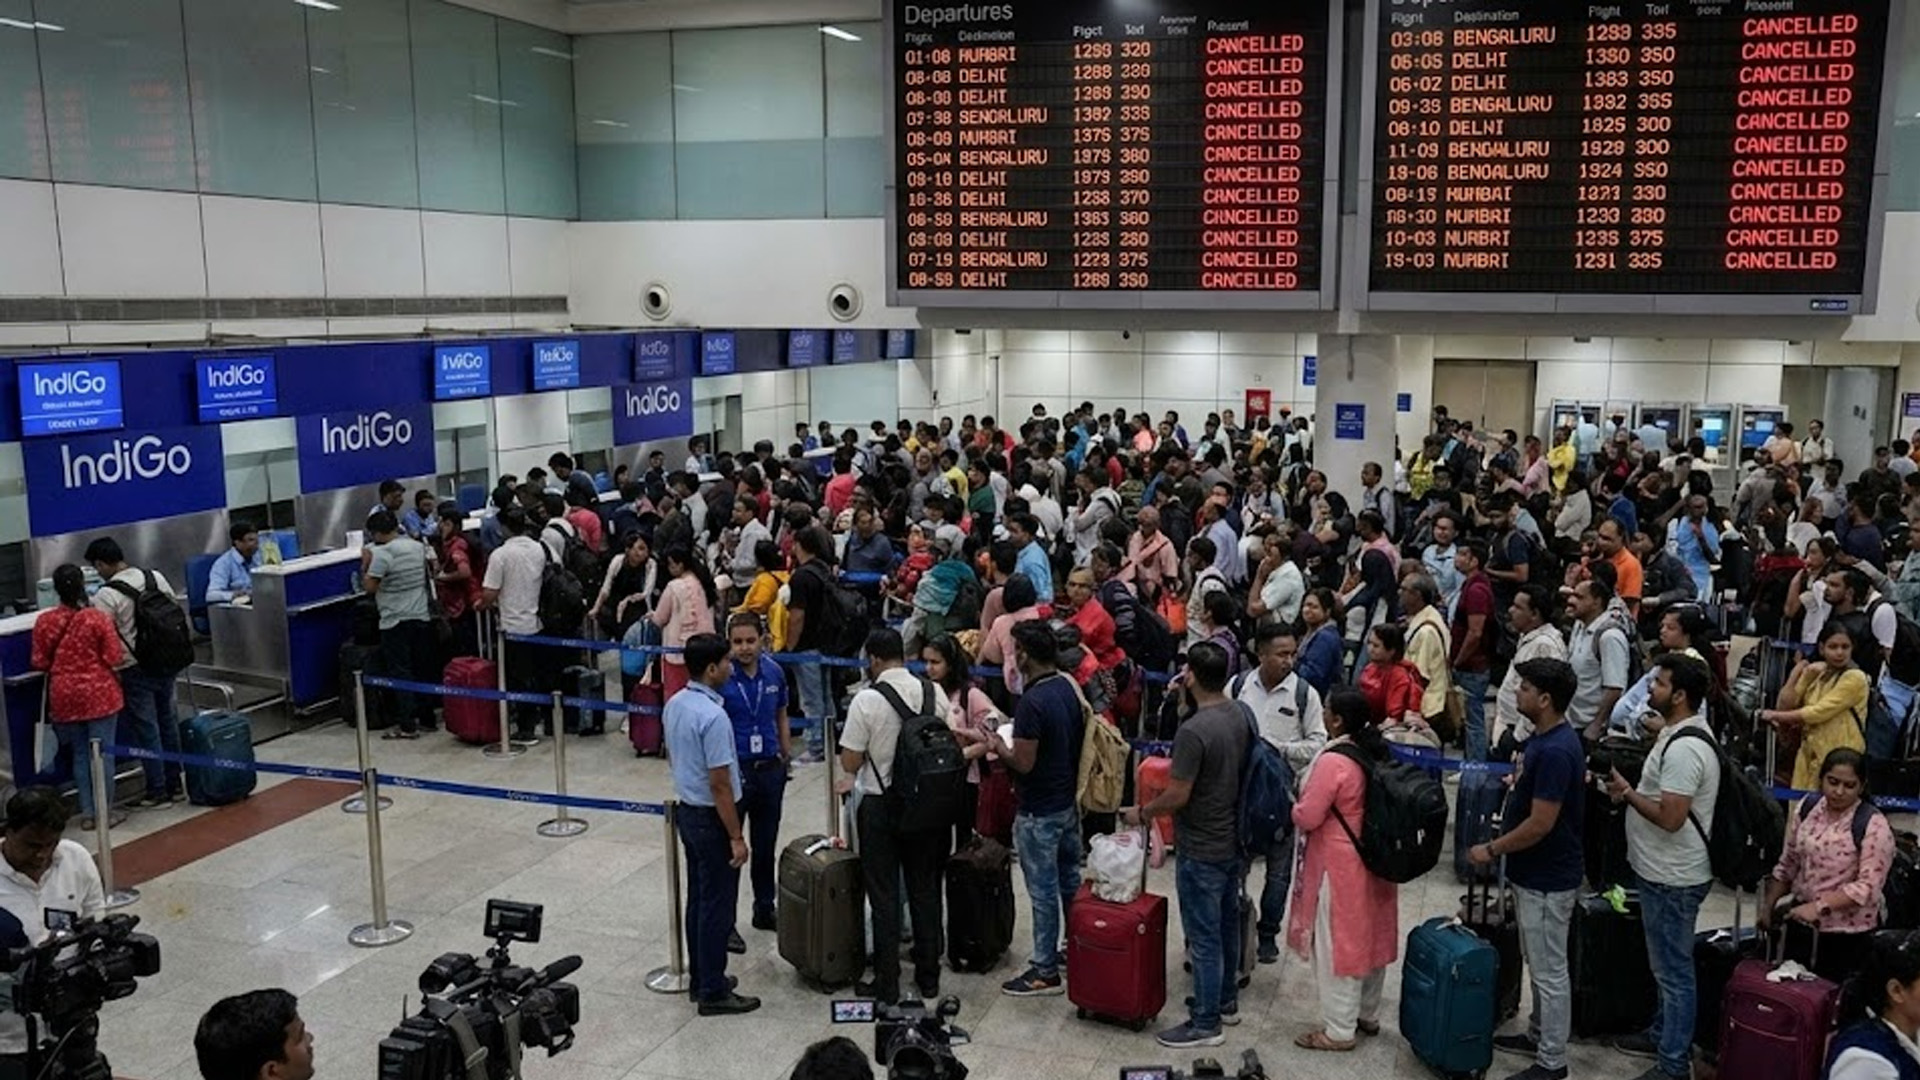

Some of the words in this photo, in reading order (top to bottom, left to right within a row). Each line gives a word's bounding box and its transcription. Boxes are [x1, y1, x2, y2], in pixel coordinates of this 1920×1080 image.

[905, 4, 1013, 28] Departures
[1743, 16, 1858, 36] CANCELLED
[1206, 36, 1302, 54] CANCELLED
[1452, 52, 1508, 69] DELHI
[1742, 40, 1856, 60] CANCELLED
[959, 68, 1006, 84] DELHI
[1205, 58, 1302, 76] CANCELLED
[1451, 74, 1506, 92] DELHI
[1739, 64, 1854, 83] CANCELLED
[1205, 80, 1302, 98] CANCELLED
[1738, 88, 1852, 107] CANCELLED
[1736, 112, 1850, 130] CANCELLED
[959, 172, 1006, 187] DELHI
[1204, 166, 1300, 183] CANCELLED
[1733, 160, 1844, 177] CANCELLED
[959, 192, 1006, 207] DELHI
[1731, 182, 1842, 200] CANCELLED
[1729, 206, 1840, 223] CANCELLED
[959, 232, 1006, 247] DELHI
[1726, 230, 1838, 246] CANCELLED
[1725, 252, 1836, 269] CANCELLED
[960, 272, 1006, 287] DELHI
[626, 386, 680, 417] IndiGo
[322, 411, 412, 454] IndiGo
[61, 436, 192, 488] IndiGo
